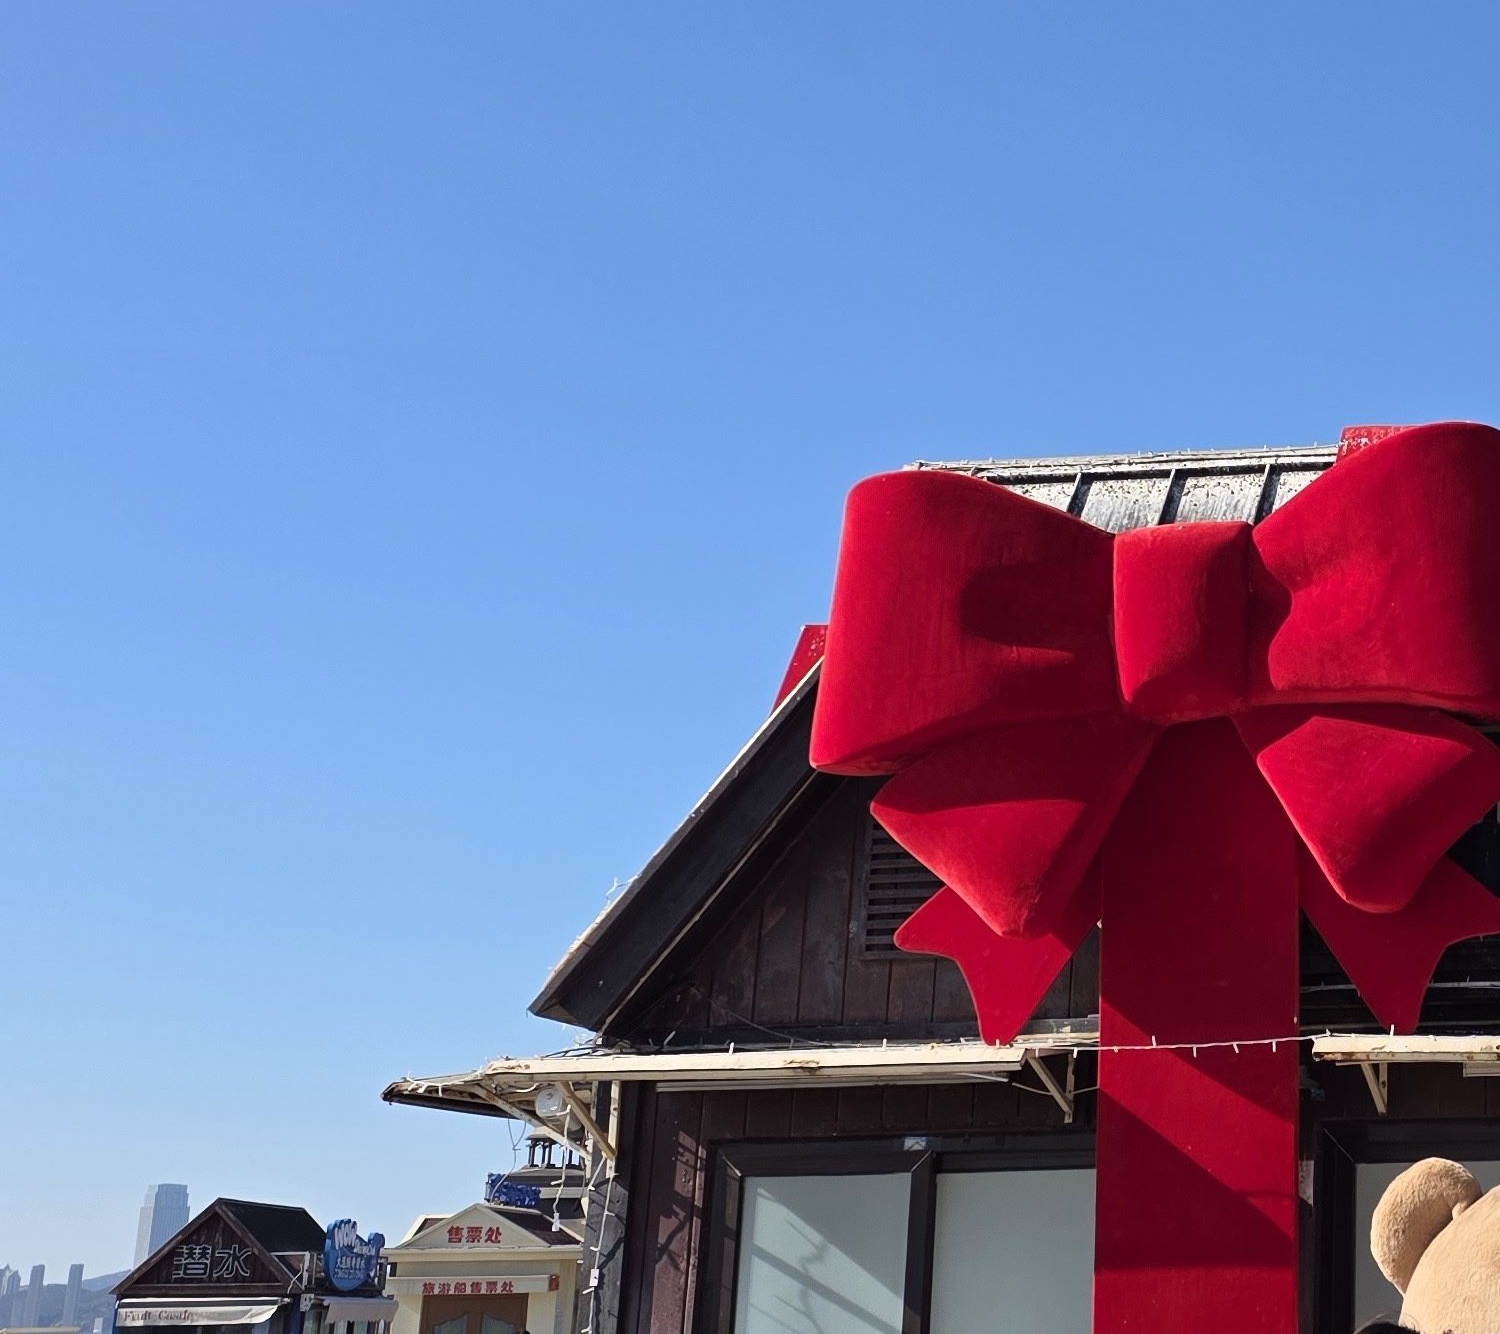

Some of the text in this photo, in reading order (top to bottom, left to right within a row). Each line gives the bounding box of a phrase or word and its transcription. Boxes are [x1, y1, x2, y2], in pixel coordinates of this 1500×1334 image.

[447, 1225, 503, 1244] 售票处
[172, 1244, 252, 1280] 潜水
[422, 1280, 514, 1295] 旅游船售票处
